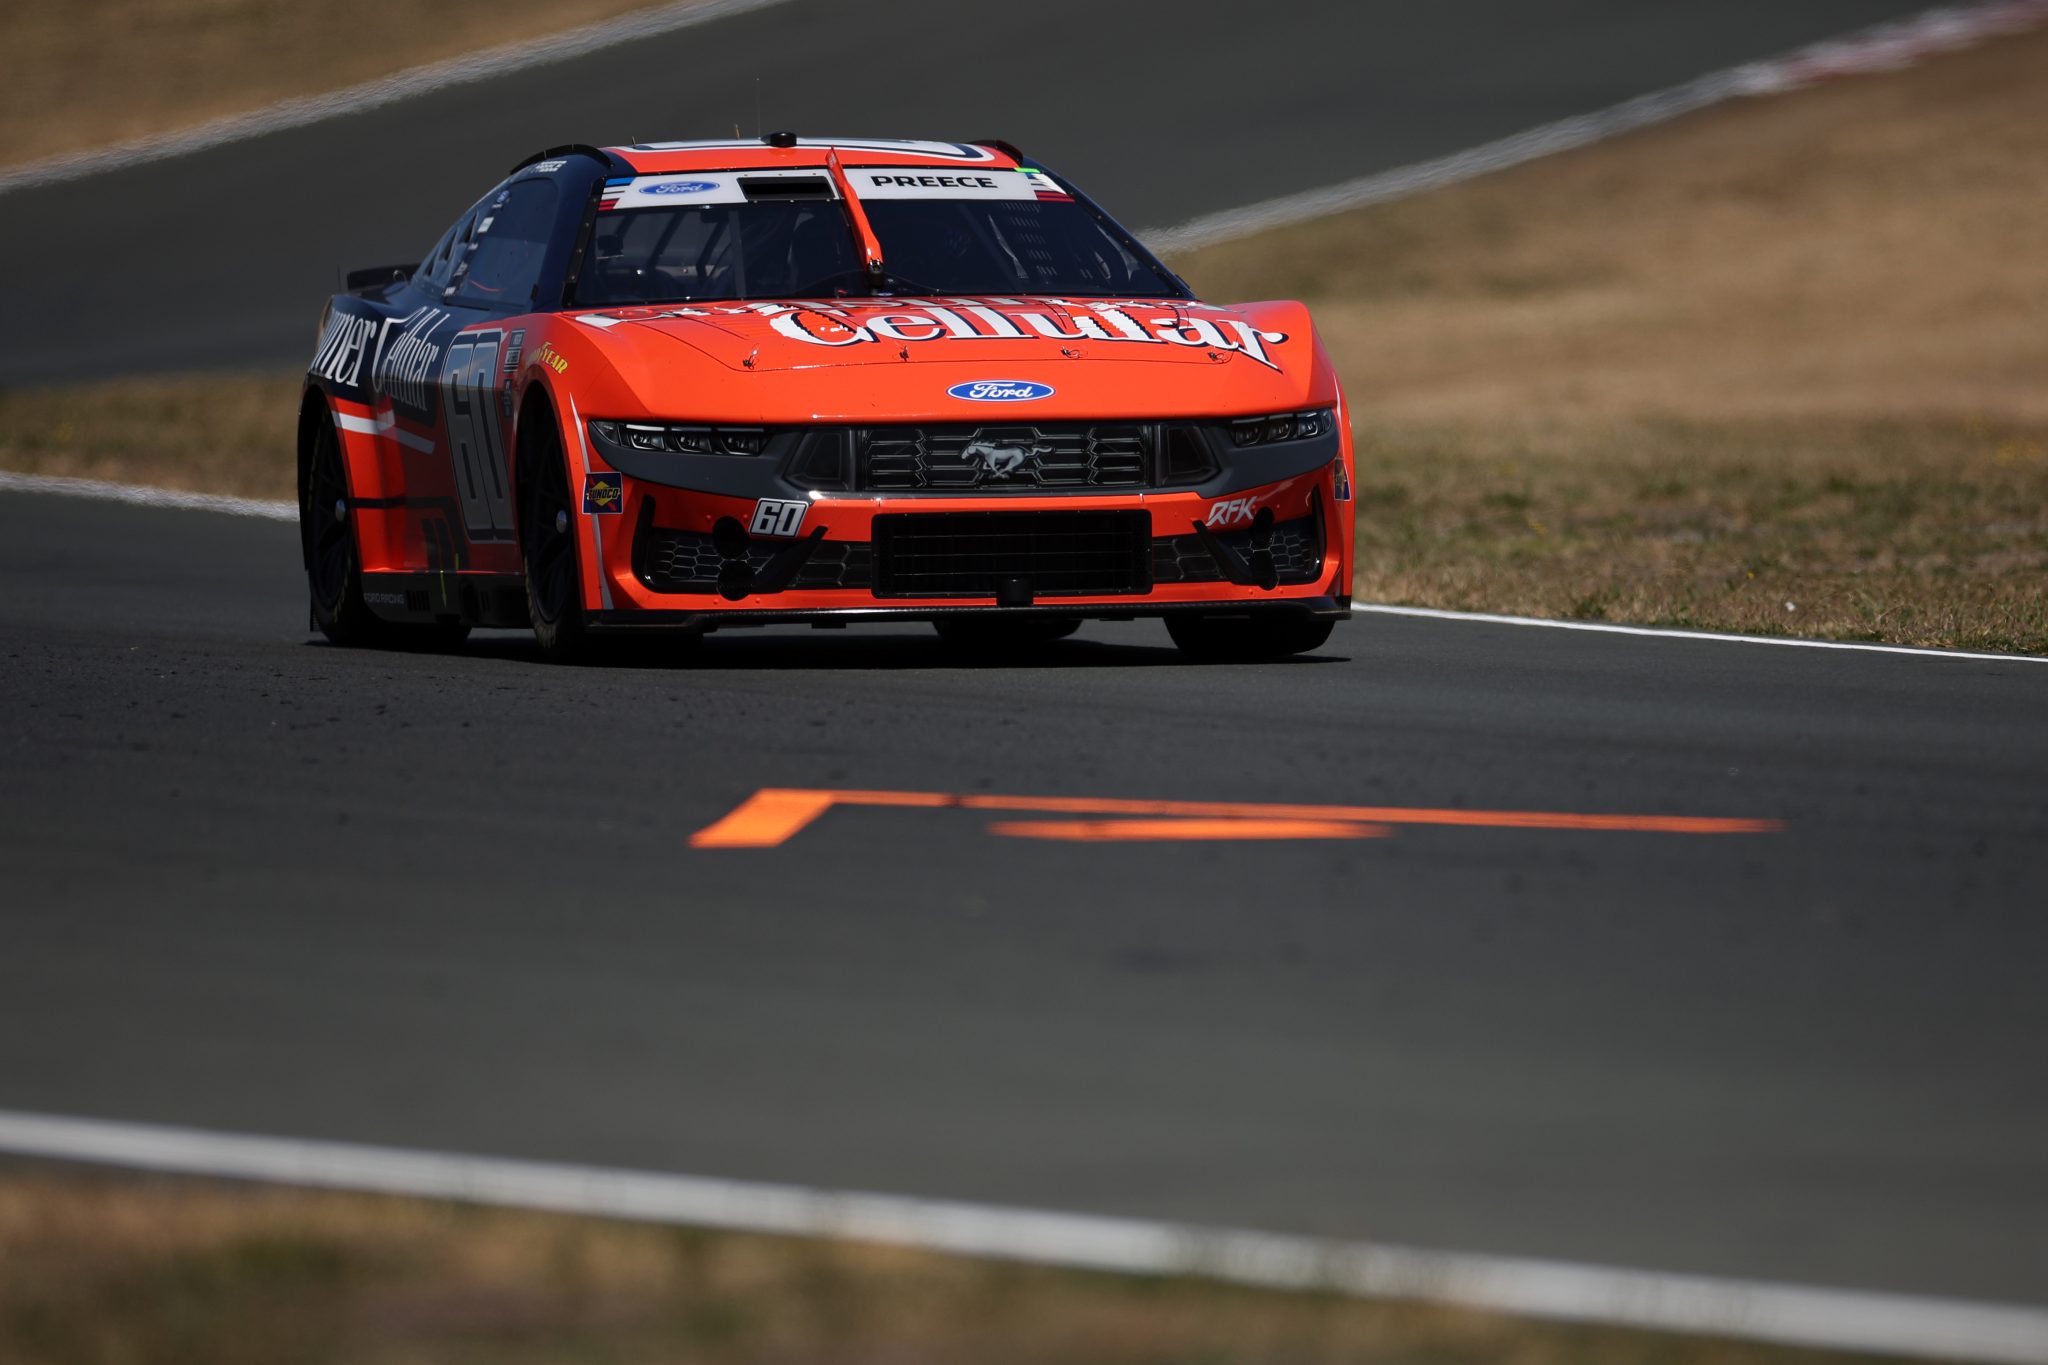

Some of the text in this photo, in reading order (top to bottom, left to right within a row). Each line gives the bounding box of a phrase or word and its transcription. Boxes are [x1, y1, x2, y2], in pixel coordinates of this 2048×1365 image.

[655, 182, 704, 194] Ford
[870, 175, 998, 189] PREECE
[769, 303, 1289, 374] Cellular
[969, 382, 1034, 399] Ford
[440, 328, 515, 544] 60
[588, 487, 619, 499] SUNOCO
[750, 499, 807, 537] 60
[1205, 496, 1257, 527] RFK
